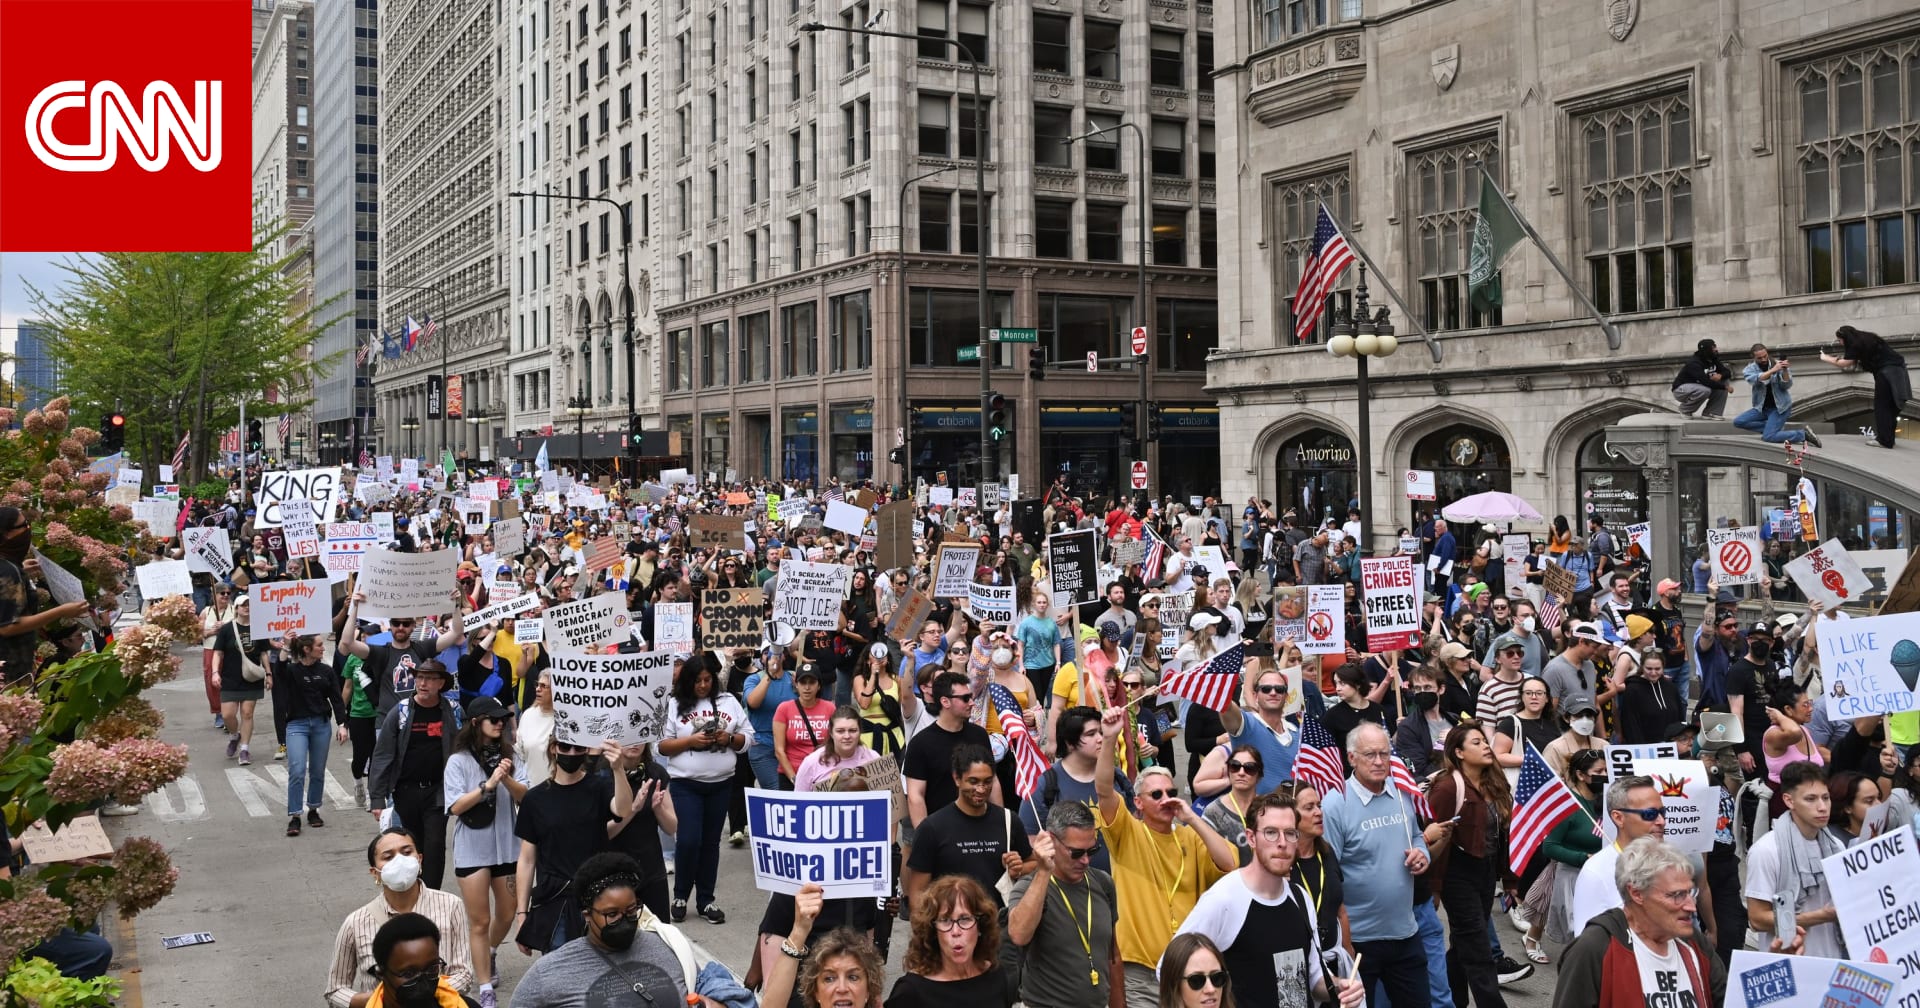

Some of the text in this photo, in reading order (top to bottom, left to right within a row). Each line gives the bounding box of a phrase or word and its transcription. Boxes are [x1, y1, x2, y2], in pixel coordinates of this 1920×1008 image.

[1004, 331, 1029, 339] Monroe
[937, 416, 974, 426] citibank
[1178, 416, 1210, 425] citibank
[1295, 443, 1350, 461] Amorino
[260, 471, 332, 505] KING
[984, 484, 998, 492] ONE
[984, 492, 998, 500] WAY
[282, 503, 299, 512] THIS
[283, 512, 310, 521] WHY IT
[532, 517, 544, 526] NO
[188, 531, 200, 543] NO
[286, 528, 314, 538] THAT HE
[328, 524, 361, 537] SIN
[700, 530, 728, 543] ICE
[1708, 528, 1757, 546] REJECT TYRANNY
[288, 539, 320, 557] LIES!
[944, 550, 976, 560] PROTEST
[1053, 544, 1080, 556] THE FALL
[328, 554, 361, 571] HIEL
[1054, 561, 1078, 573] TRUMP
[1363, 560, 1410, 572] STOP POLICE
[946, 564, 968, 577] NOW
[1055, 570, 1082, 582] FASCIST
[1056, 579, 1084, 591] REGIME
[1364, 570, 1412, 590] CRIMES
[1716, 574, 1737, 584] LIBERTY
[1749, 574, 1758, 583] ALL
[260, 582, 316, 603] Empathy
[706, 590, 730, 604] NO
[969, 584, 991, 598] HANDS
[993, 589, 1012, 599] OFF
[276, 602, 300, 616] isn't
[784, 596, 807, 616] NOT
[1375, 594, 1405, 612] FREE
[464, 598, 532, 628] CAGO WON'T BE SILENT
[550, 602, 594, 620] PROTECT
[702, 605, 762, 620] CROWN
[972, 605, 1012, 622] CHICAGO
[268, 616, 306, 632] radical
[710, 617, 759, 634] FOR A
[790, 616, 834, 628] OUR streets
[1368, 612, 1416, 628] THEM ALL
[702, 634, 762, 648] CLOWN
[1163, 630, 1176, 638] OFF
[1828, 632, 1880, 656] I LIKE
[552, 654, 670, 674] I LOVE SOMEONE
[1836, 658, 1864, 678] MY
[553, 675, 648, 690] WHO HAD AN
[1856, 675, 1880, 693] ICE
[553, 691, 628, 708] ABORTION
[1838, 691, 1914, 716] CRUSHED
[680, 712, 698, 726] MON
[788, 719, 830, 729] I'M ROM
[866, 757, 897, 778] ITERALLY
[1664, 805, 1700, 813] KINGS.
[765, 804, 864, 840] ICE OUT!
[1361, 816, 1408, 832] CHICAGO
[1666, 827, 1700, 836] EOVER.
[834, 846, 882, 880] ICE!
[1842, 834, 1904, 878] NO ONE
[1878, 885, 1896, 910] IS
[1655, 970, 1678, 992] BE
[1746, 967, 1788, 988] ABOLISH
[1831, 966, 1890, 1006] CHINGA
[1850, 994, 1862, 1004] LA
